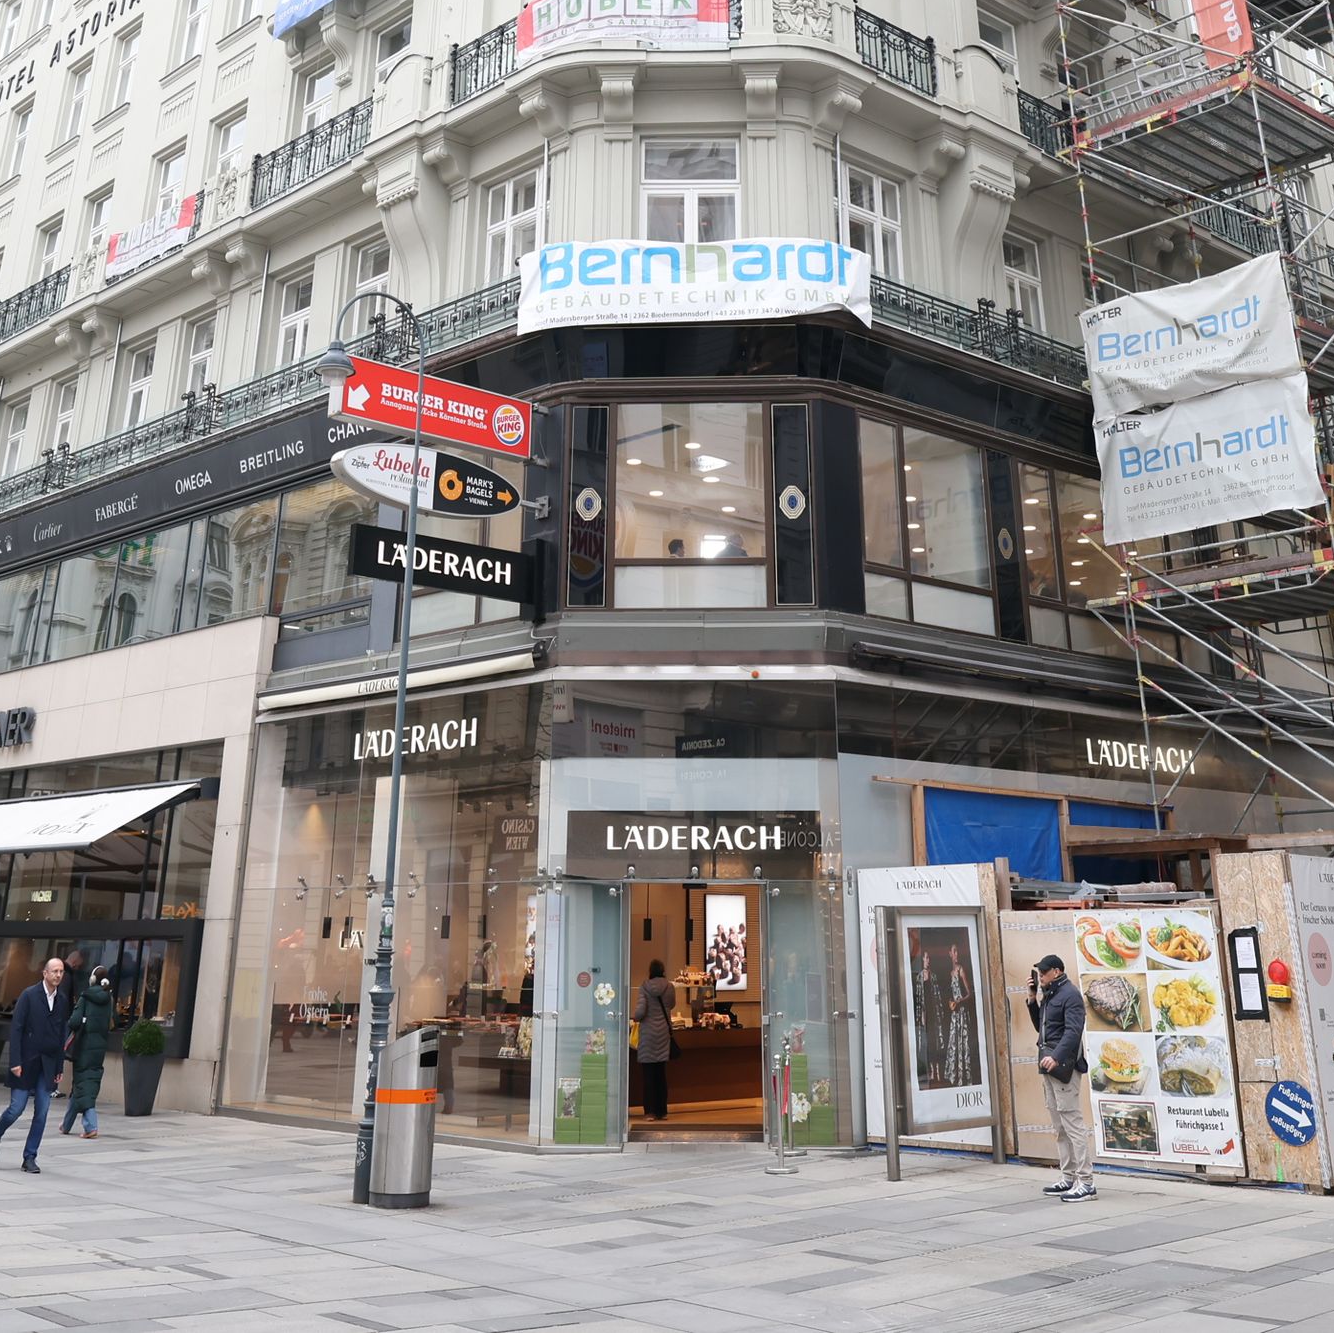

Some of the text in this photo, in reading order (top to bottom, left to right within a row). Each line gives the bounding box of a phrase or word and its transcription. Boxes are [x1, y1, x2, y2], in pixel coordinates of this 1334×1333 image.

[539, 241, 852, 293] Bernhardt
[536, 288, 766, 313] GEBÄUDETECHNIK
[1086, 306, 1122, 329] HOLTER
[1097, 295, 1261, 362] Bernhardt
[1097, 345, 1217, 374] GEBÄUDETECHNIK
[381, 383, 485, 420] BURGER KING
[439, 411, 466, 425] Kärntner
[467, 418, 487, 430] Straße
[496, 414, 521, 424] BURGER
[497, 421, 521, 434] KING
[1103, 421, 1141, 439] HOLTER
[239, 440, 304, 473] BREITLING
[1118, 415, 1288, 479] Bernhardt
[175, 470, 212, 495] OMEGA
[466, 476, 494, 489] MARK'S
[1123, 454, 1290, 495] GEBÄUDETECHNIK GMBH
[466, 486, 493, 499] BAGELS
[469, 496, 488, 507] VIENNA
[95, 494, 138, 522] FABERGÉ
[33, 523, 63, 543] Cartier
[377, 540, 511, 585] LÄDERACH
[353, 718, 478, 761] LÄDERACH
[1086, 738, 1196, 775] LÄDERACH
[606, 825, 782, 851] LÄDERACH
[303, 986, 327, 1002] Frohe
[299, 1003, 329, 1019] Ostern
[956, 1091, 984, 1109] DIOR
[1278, 1083, 1314, 1110] Fußgänger
[1167, 1105, 1230, 1118] Restaurant Lubella
[1176, 1120, 1225, 1132] Führichgasse 1
[1271, 1115, 1307, 1143] Fußgänger
[1172, 1141, 1211, 1154] LUBELLA
